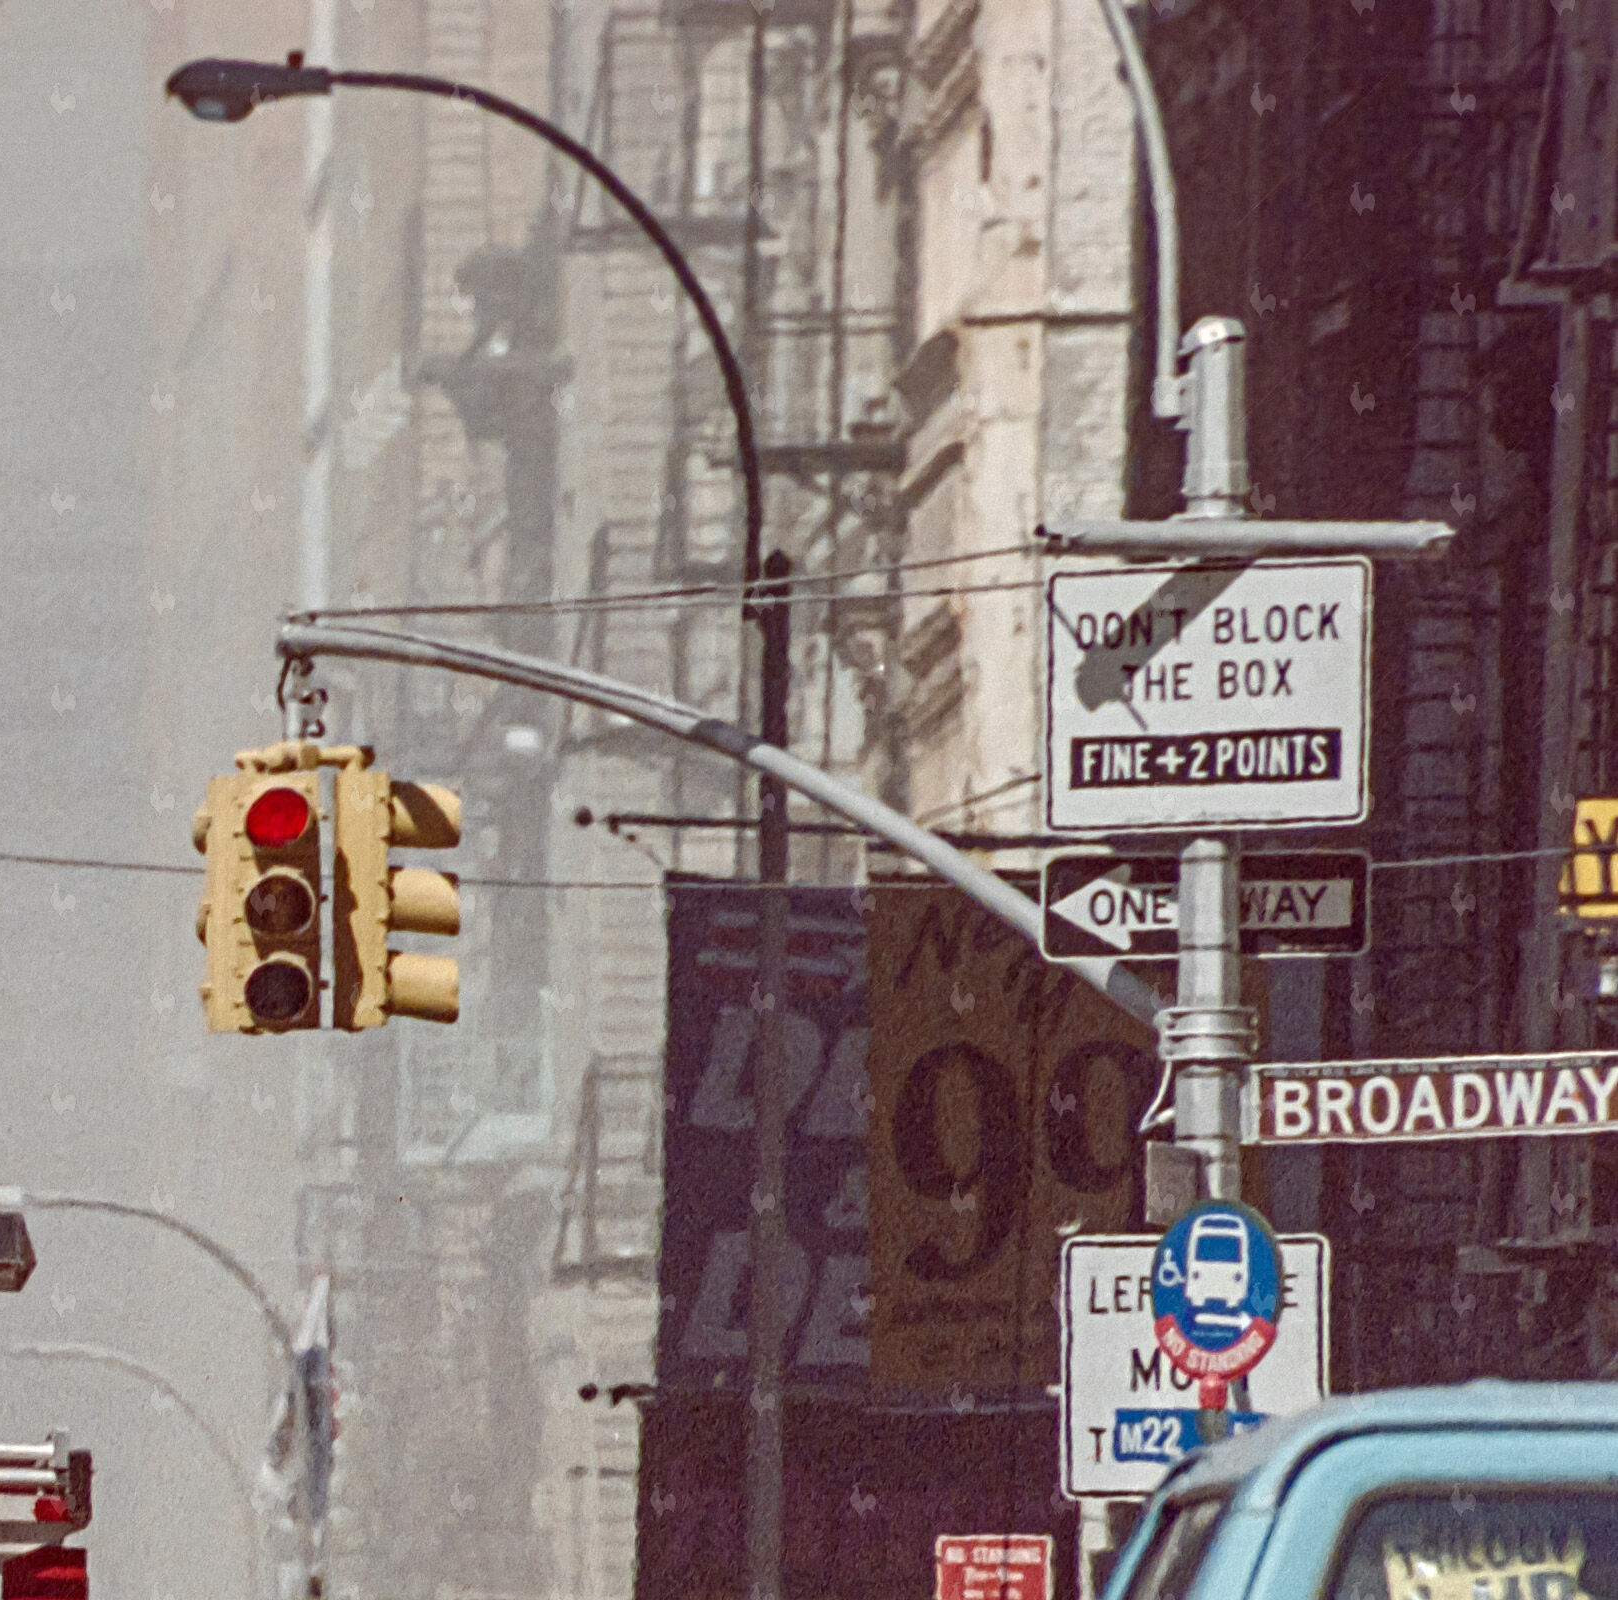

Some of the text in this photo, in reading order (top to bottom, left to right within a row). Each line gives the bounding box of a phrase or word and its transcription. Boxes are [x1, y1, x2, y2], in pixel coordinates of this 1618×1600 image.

[1214, 603, 1341, 645] BLOCK
[1122, 658, 1293, 702] THE BOX
[1082, 743, 1152, 781] FINE
[1216, 735, 1329, 776] POINTS
[1089, 883, 1329, 926] ONE WAY
[1274, 1066, 1618, 1137] BROADWAY
[1089, 1275, 1152, 1315] LEF
[1119, 1417, 1184, 1455] M22
